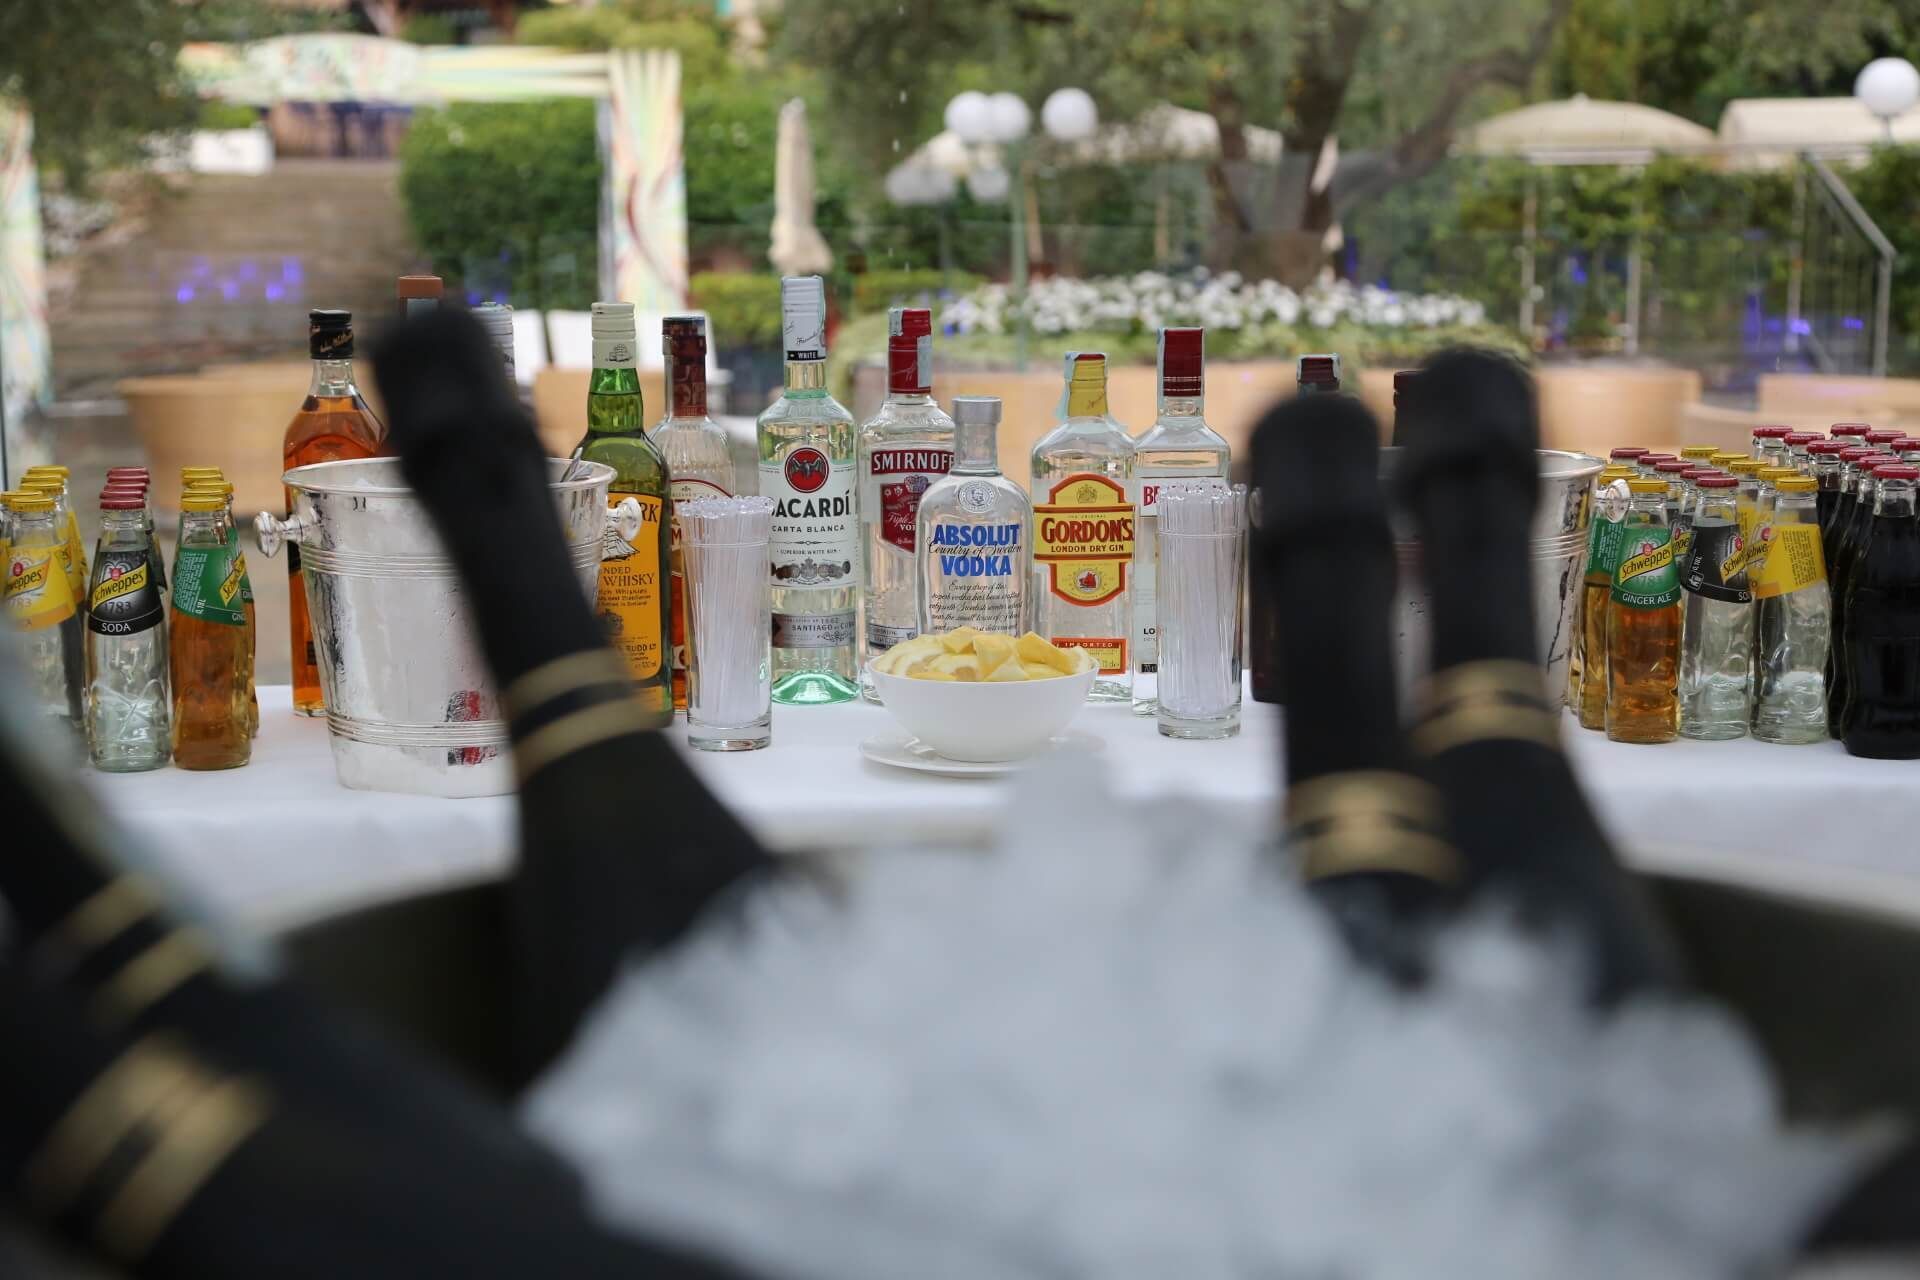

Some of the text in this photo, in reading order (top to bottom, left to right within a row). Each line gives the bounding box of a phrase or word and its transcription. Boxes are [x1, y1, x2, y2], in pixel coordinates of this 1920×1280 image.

[797, 351, 817, 359] WHITE
[874, 452, 954, 471] SMIRNOFF
[772, 490, 850, 518] ACARDÍ
[772, 525, 844, 533] CARTA BLANCA
[933, 524, 1020, 546] ABSOLUT
[1041, 517, 1132, 544] GORDON'S
[928, 540, 970, 560] Country
[1090, 544, 1107, 552] DRY
[1109, 543, 1124, 551] GIN
[941, 555, 1012, 577] VODKA
[95, 570, 144, 604] Schweppes
[603, 573, 655, 587] WHISKY
[1622, 593, 1671, 605] GINGER ALE
[102, 622, 131, 632] SODA
[792, 624, 833, 632] SANTIAGO
